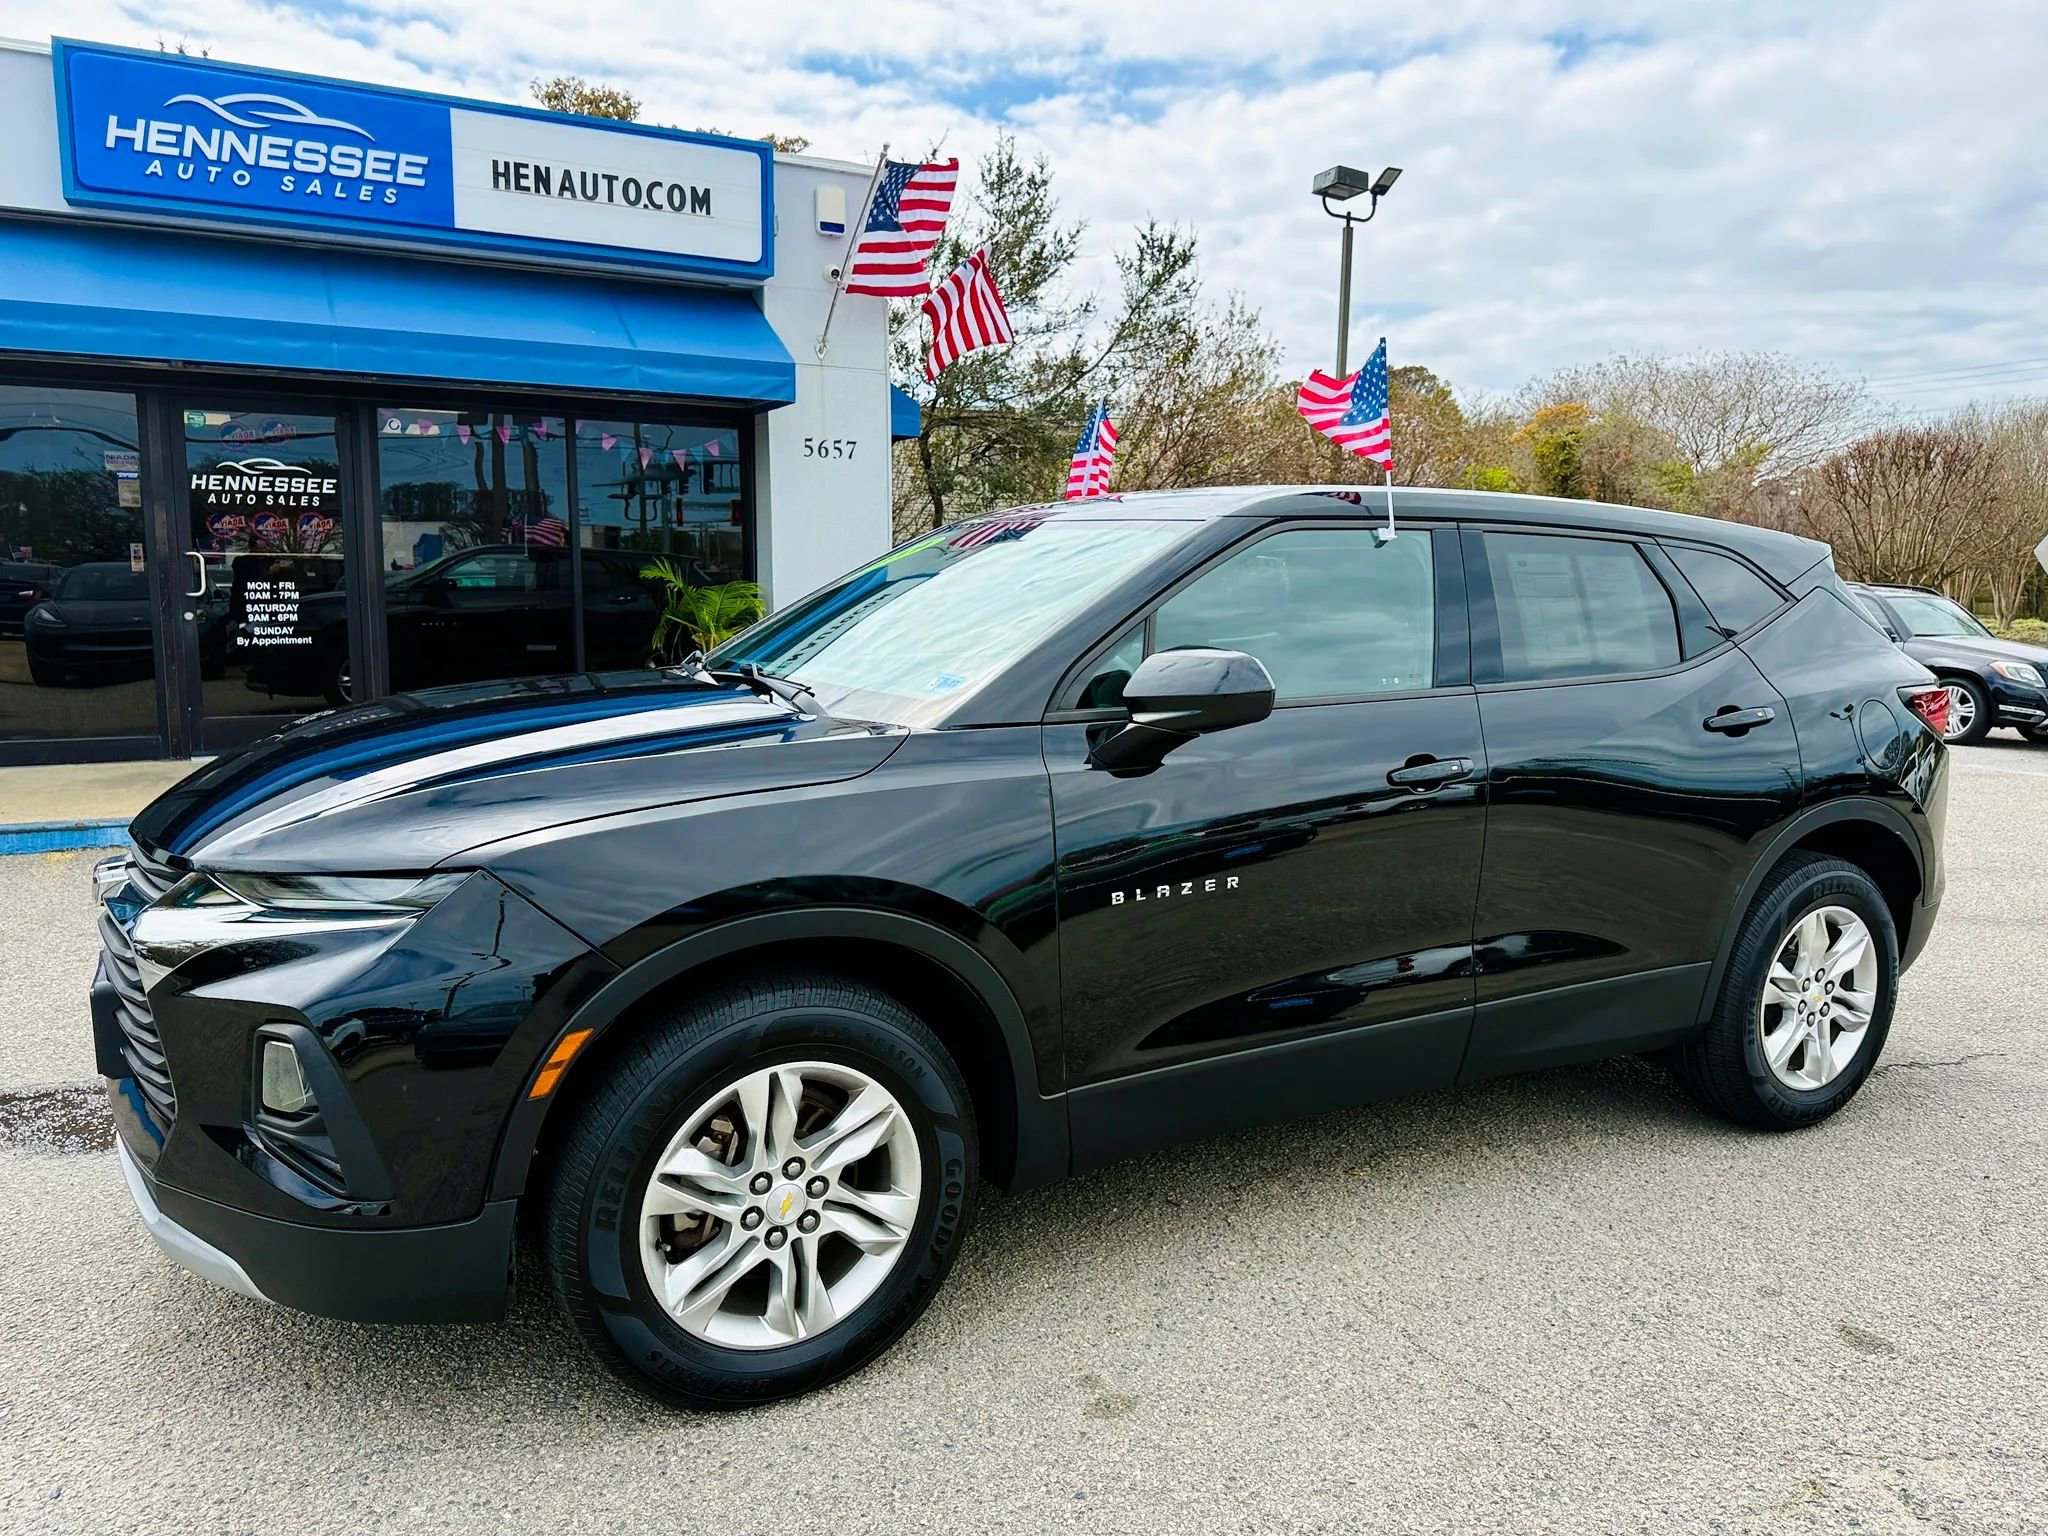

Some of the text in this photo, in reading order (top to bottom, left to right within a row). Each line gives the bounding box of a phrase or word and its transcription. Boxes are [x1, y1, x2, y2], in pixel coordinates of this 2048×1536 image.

[105, 114, 429, 187] HENNESSEE
[145, 159, 398, 205] AUTO SALES
[491, 159, 712, 217] HENAUTO.COM
[803, 436, 857, 460] 5657
[191, 474, 338, 494] HENNESSEE
[207, 493, 320, 507] AUTO SALES
[246, 581, 271, 590] MON
[278, 581, 295, 590] FRI
[244, 591, 271, 600] 10AM
[278, 591, 300, 600] 7PM
[245, 603, 299, 613] SATURDAY
[247, 613, 270, 622] 9AM
[277, 613, 298, 622] 6PM
[253, 626, 294, 635] SUNDAY
[236, 636, 313, 647] By Appointment
[1111, 876, 1240, 906] BLAZER
